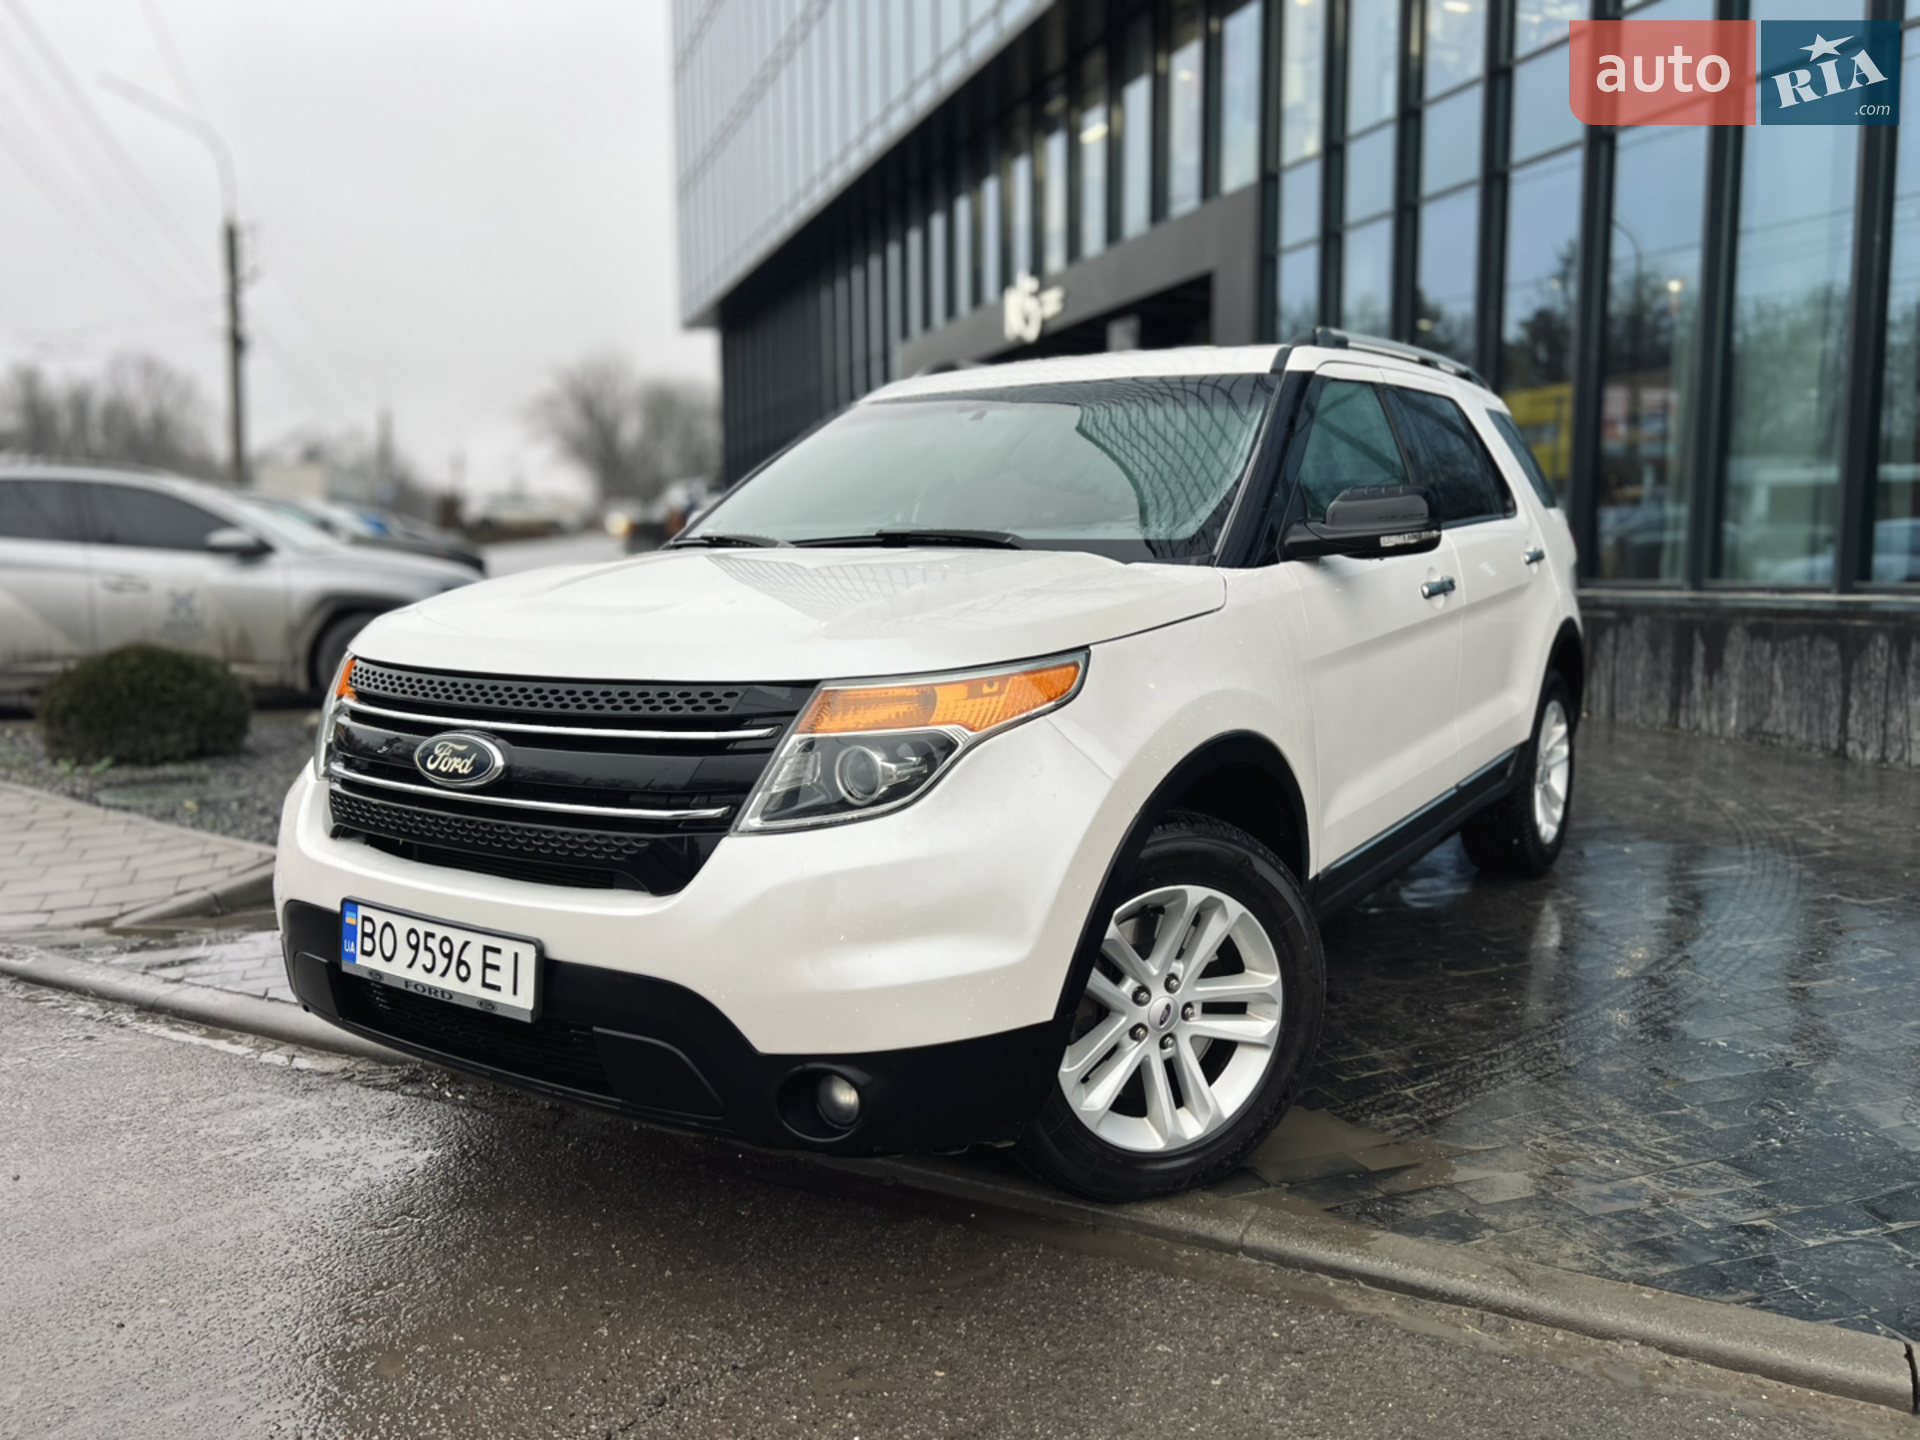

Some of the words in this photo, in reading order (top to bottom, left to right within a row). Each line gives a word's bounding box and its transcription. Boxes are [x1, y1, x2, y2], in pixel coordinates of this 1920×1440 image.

[426, 741, 477, 774] Ford
[343, 939, 356, 955] UA
[360, 914, 398, 963] BO
[406, 927, 472, 983] 9596
[404, 980, 454, 1001] FORD
